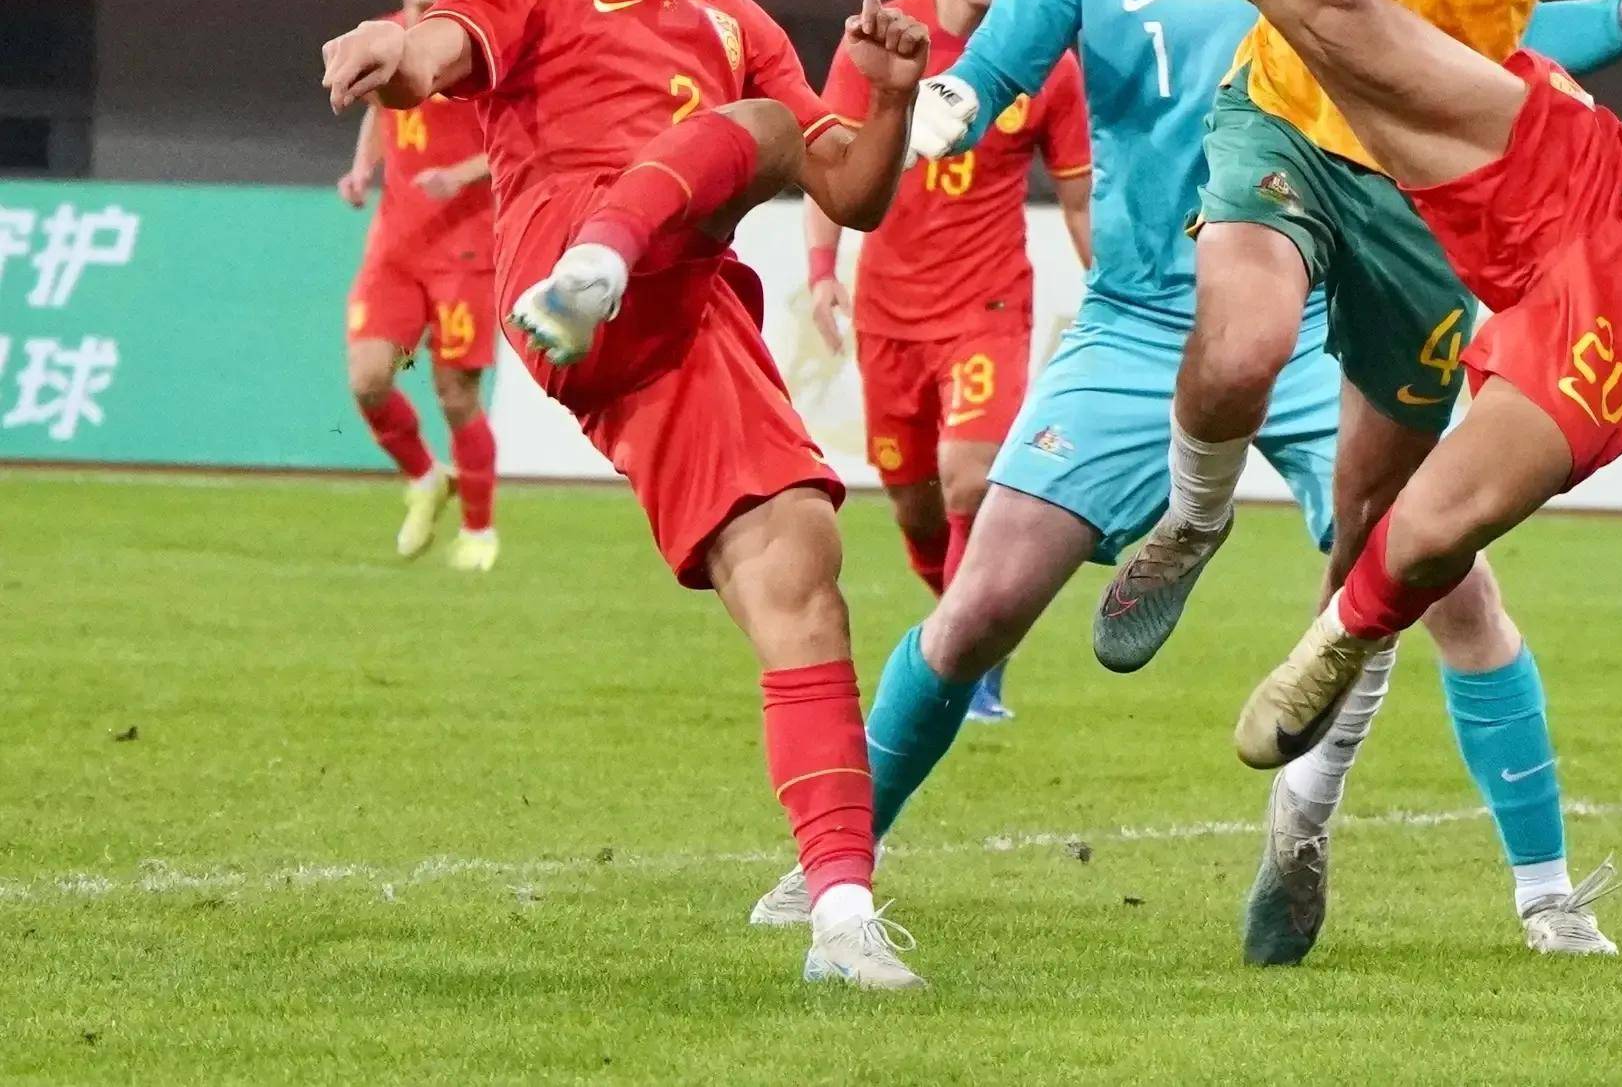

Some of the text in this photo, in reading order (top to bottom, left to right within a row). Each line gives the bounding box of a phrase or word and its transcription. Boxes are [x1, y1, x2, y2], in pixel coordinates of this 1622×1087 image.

[1143, 21, 1171, 97] 1
[950, 352, 996, 410] 13
[1420, 308, 1465, 387] 4
[0, 336, 119, 440] 球
